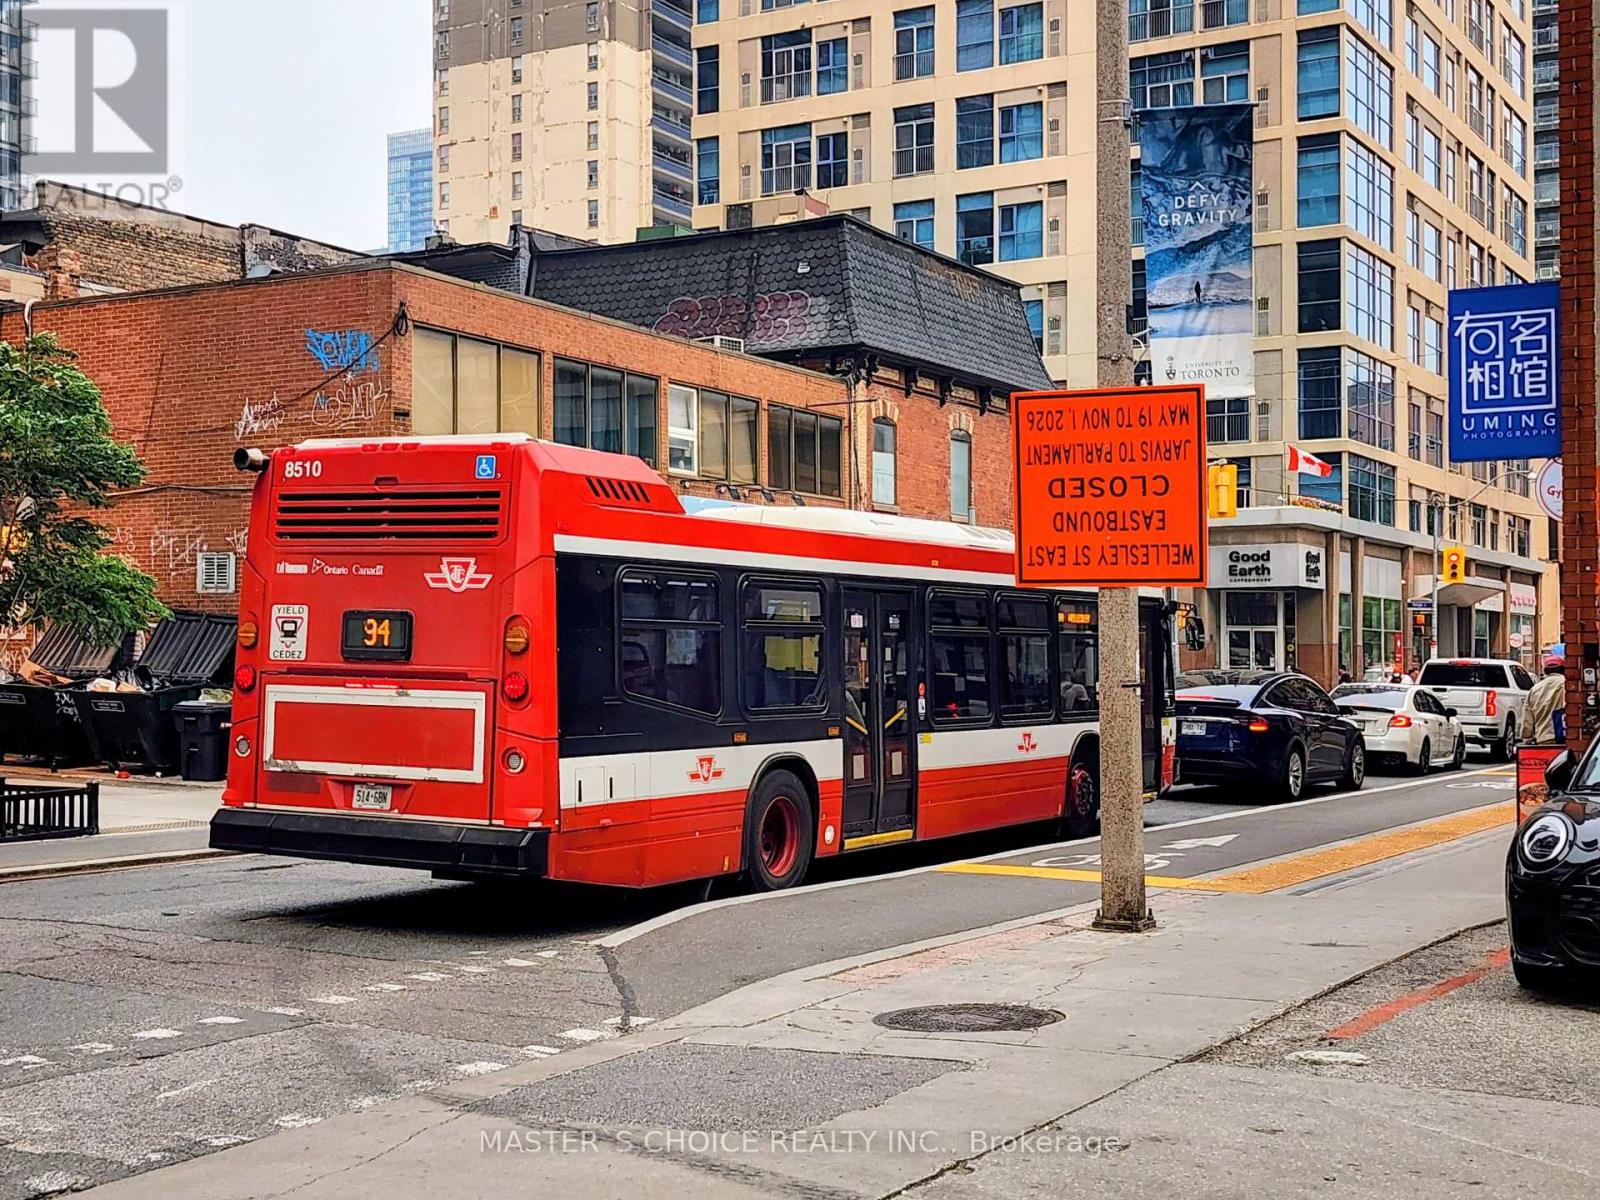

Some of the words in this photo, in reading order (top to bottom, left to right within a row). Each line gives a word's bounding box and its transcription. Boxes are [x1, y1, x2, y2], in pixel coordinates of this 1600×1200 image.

[1174, 193, 1221, 209] DEFY
[1159, 209, 1237, 227] GRAVITY
[1181, 366, 1240, 380] TORONTO
[1185, 360, 1222, 369] UNIVERSITY
[1467, 356, 1547, 401] 相馆
[1027, 410, 1064, 432] 2026
[1082, 408, 1110, 430] NOV
[1116, 407, 1133, 428] TO
[1139, 405, 1152, 428] 19
[1159, 404, 1190, 427] MAY
[1462, 412, 1556, 431] UMING
[1463, 428, 1556, 440] PHOTOGRAPHY
[1026, 441, 1113, 466] PARLIAMENT
[1119, 441, 1135, 463] TO
[1141, 439, 1192, 463] JARVIS
[284, 460, 322, 478] 8510
[1048, 475, 1170, 498] CLOSED
[1053, 509, 1166, 533] EASTBOUND
[1027, 545, 1066, 567] EAST
[1073, 545, 1091, 567] ST
[1098, 543, 1195, 566] WELLESLEY
[1228, 549, 1271, 563] Good
[323, 565, 349, 575] Ontario
[352, 564, 384, 576] Canada
[1228, 563, 1271, 577] Earth
[275, 606, 305, 615] YIELD
[363, 617, 391, 647] 94
